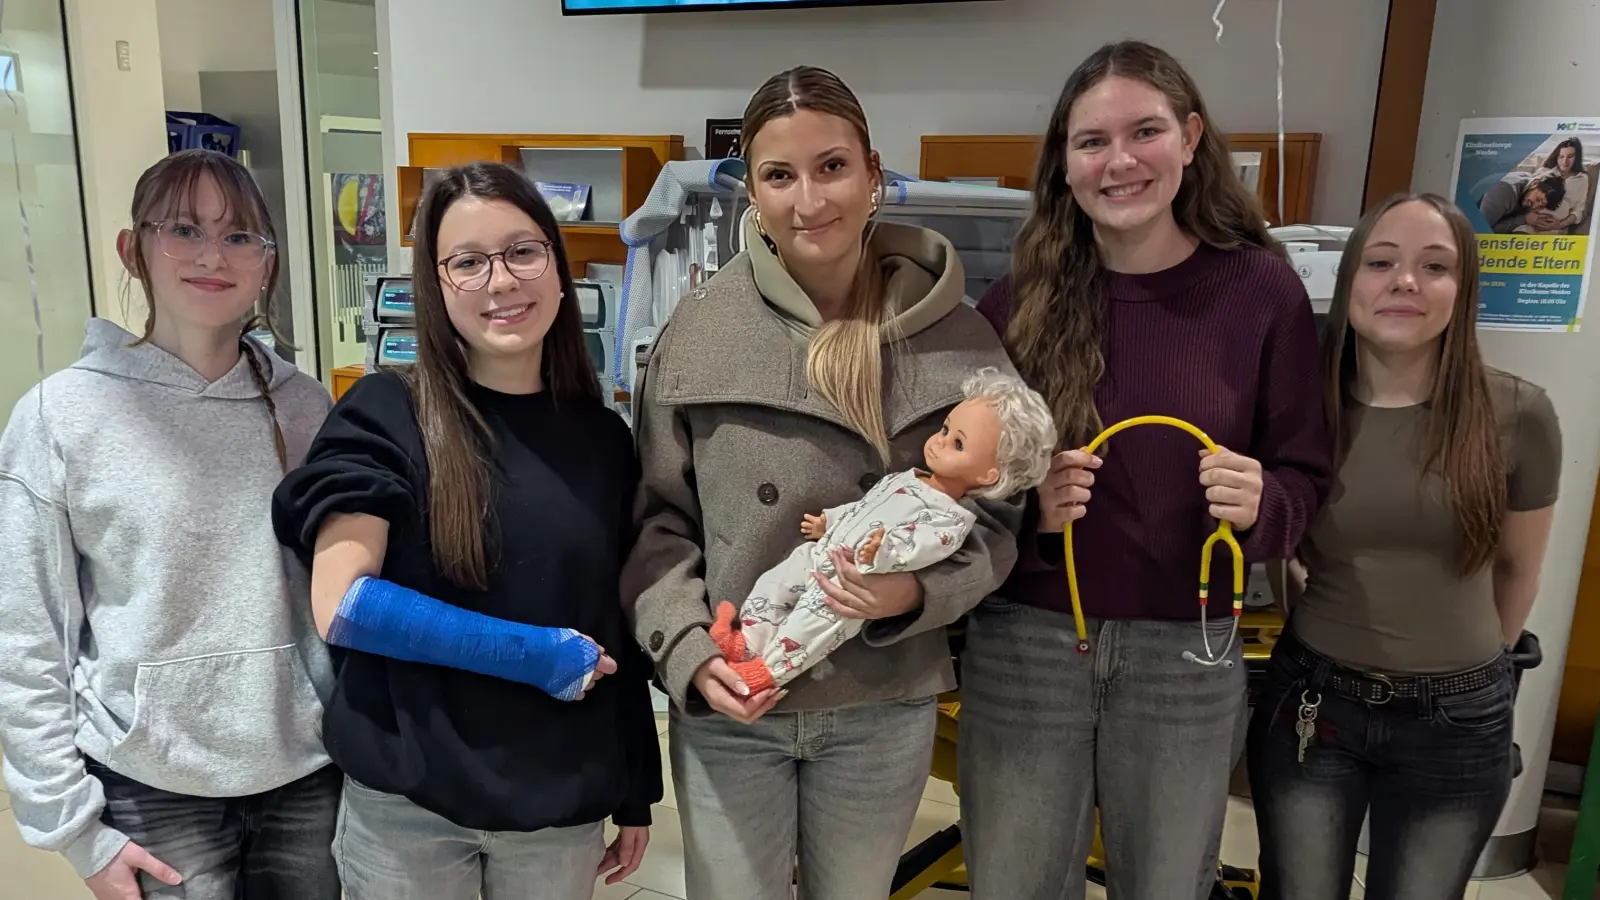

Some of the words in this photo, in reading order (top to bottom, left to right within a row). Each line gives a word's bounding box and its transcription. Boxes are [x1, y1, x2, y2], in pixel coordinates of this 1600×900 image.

[1479, 237, 1548, 251] ensfeier
[1552, 238, 1576, 251] für
[1532, 256, 1580, 270] Eltern
